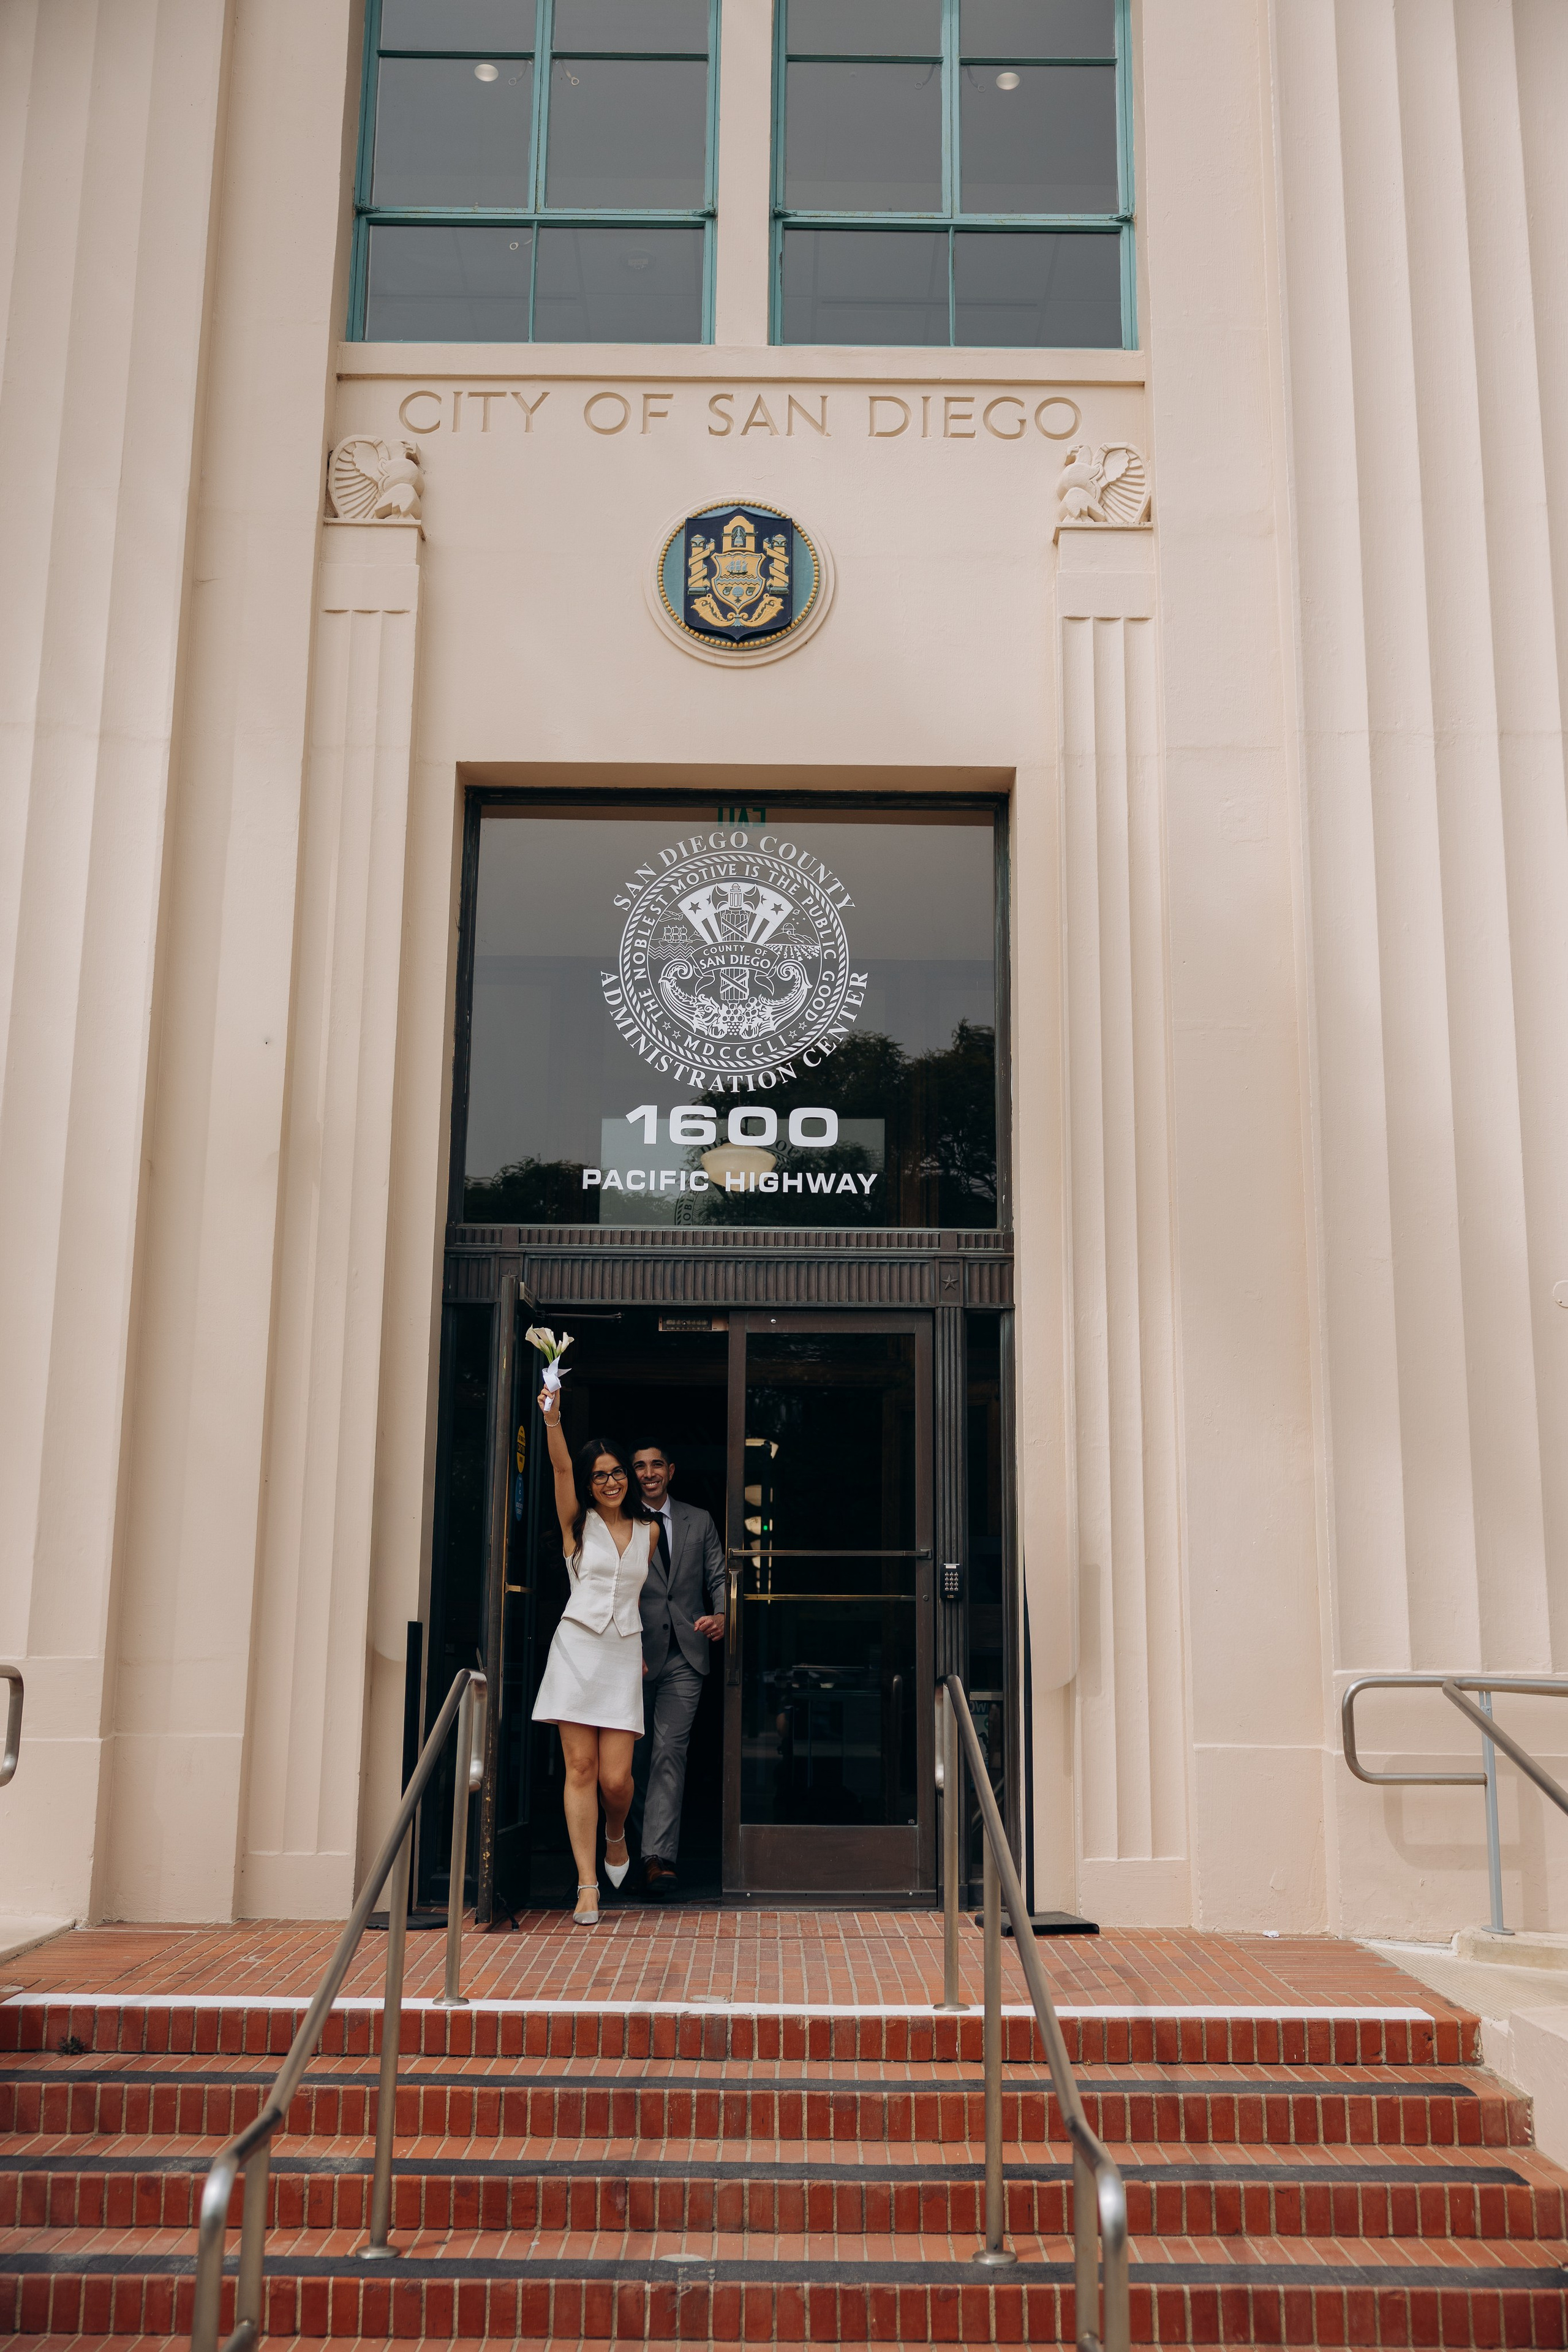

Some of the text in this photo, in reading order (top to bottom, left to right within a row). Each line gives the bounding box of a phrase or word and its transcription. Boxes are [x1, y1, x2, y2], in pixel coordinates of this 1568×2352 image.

[399, 390, 1082, 440] CITY OF SAN DIEGO
[614, 831, 856, 912] SAN DIEGO COUNTY
[633, 864, 837, 1023] THE NOBLEST MOTIVE IS THE PUBLIC GOOD
[699, 954, 771, 970] SAN DIEGO
[703, 944, 767, 957] COUNTY OF
[600, 970, 868, 1093] ADMINISTRATION CENTER
[684, 1035, 791, 1060] MDCCCLI
[625, 1104, 839, 1147] 1600
[582, 1169, 878, 1194] PACIFIC HIGHWAY
